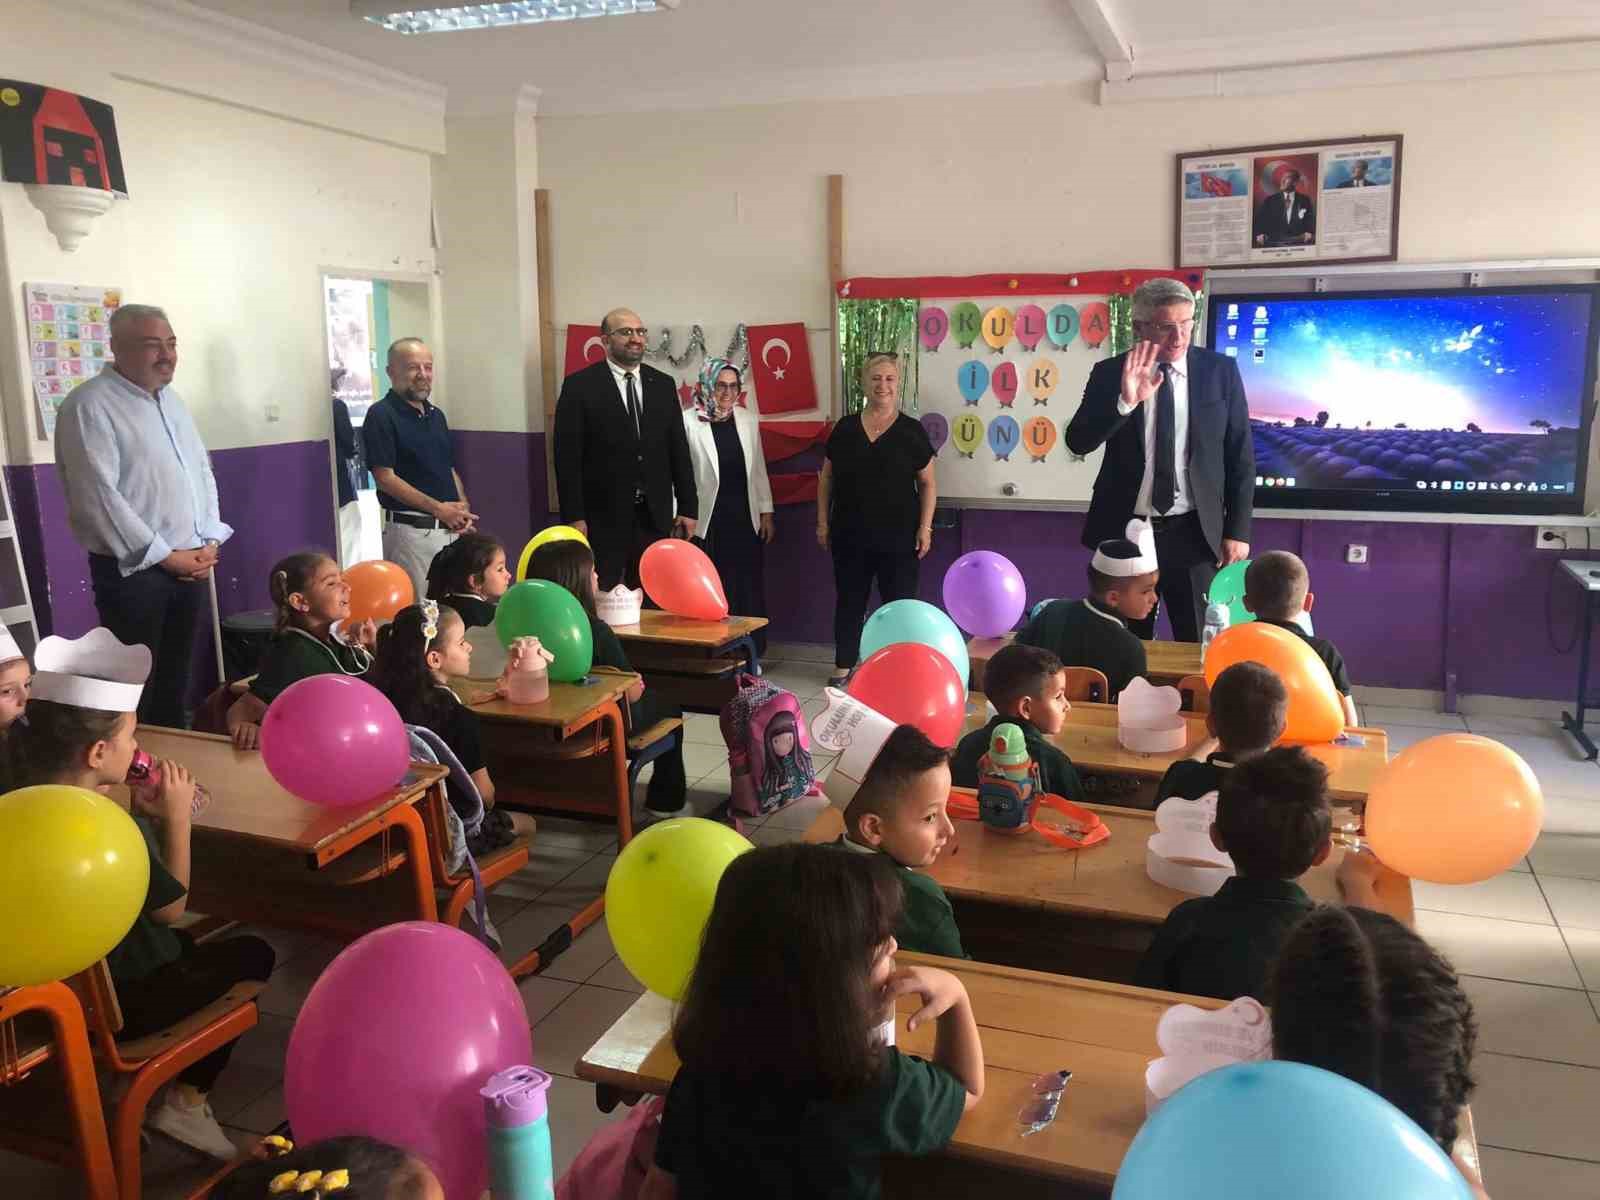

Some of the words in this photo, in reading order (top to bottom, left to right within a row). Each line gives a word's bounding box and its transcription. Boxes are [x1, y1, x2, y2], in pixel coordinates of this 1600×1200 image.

[925, 313, 1103, 336] OKULDA
[971, 365, 1050, 391] İLK
[927, 418, 1047, 446] GÜNÜ
